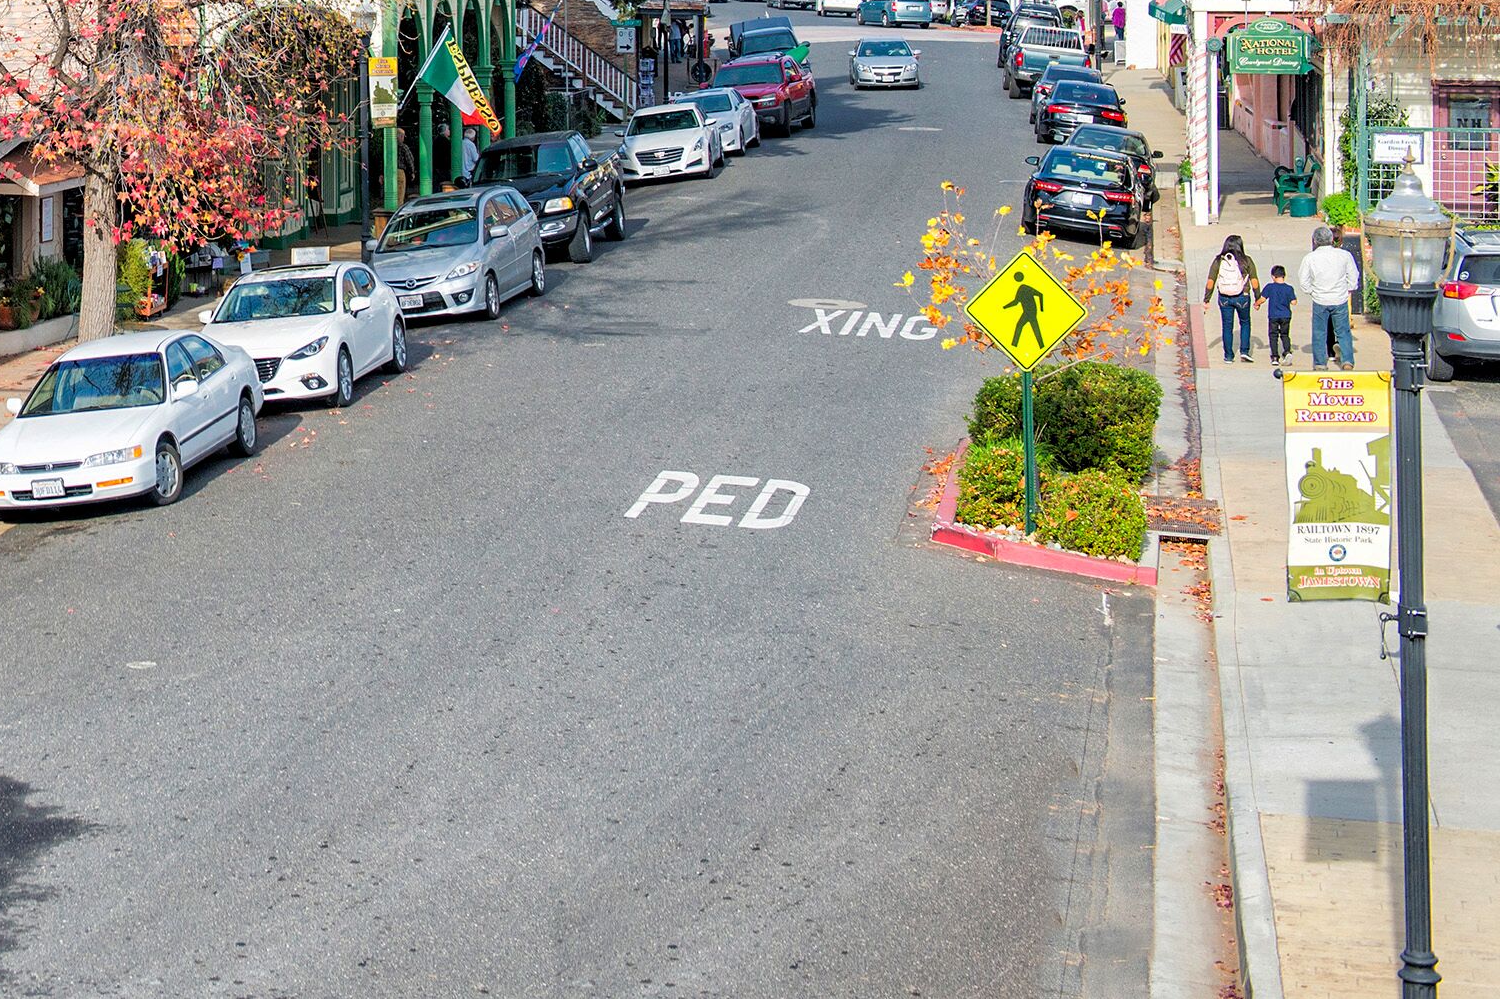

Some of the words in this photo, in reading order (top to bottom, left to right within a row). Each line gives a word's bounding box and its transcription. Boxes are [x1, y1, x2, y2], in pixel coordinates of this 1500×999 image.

[1241, 38, 1297, 50] NATIONAL
[1239, 57, 1272, 66] Courtyard
[1272, 57, 1299, 66] Dining
[798, 308, 940, 340] XING
[1317, 377, 1354, 390] THE
[1308, 392, 1364, 406] MOVIE
[1295, 409, 1378, 422] RAILROAD
[623, 470, 811, 529] PED
[1297, 525, 1351, 534] RAILTOWN
[1355, 525, 1381, 535] 1897
[1354, 536, 1373, 544] Park
[1314, 567, 1325, 575] in
[1326, 566, 1363, 576] Uptown
[1298, 575, 1381, 589] JAMESTOWN
